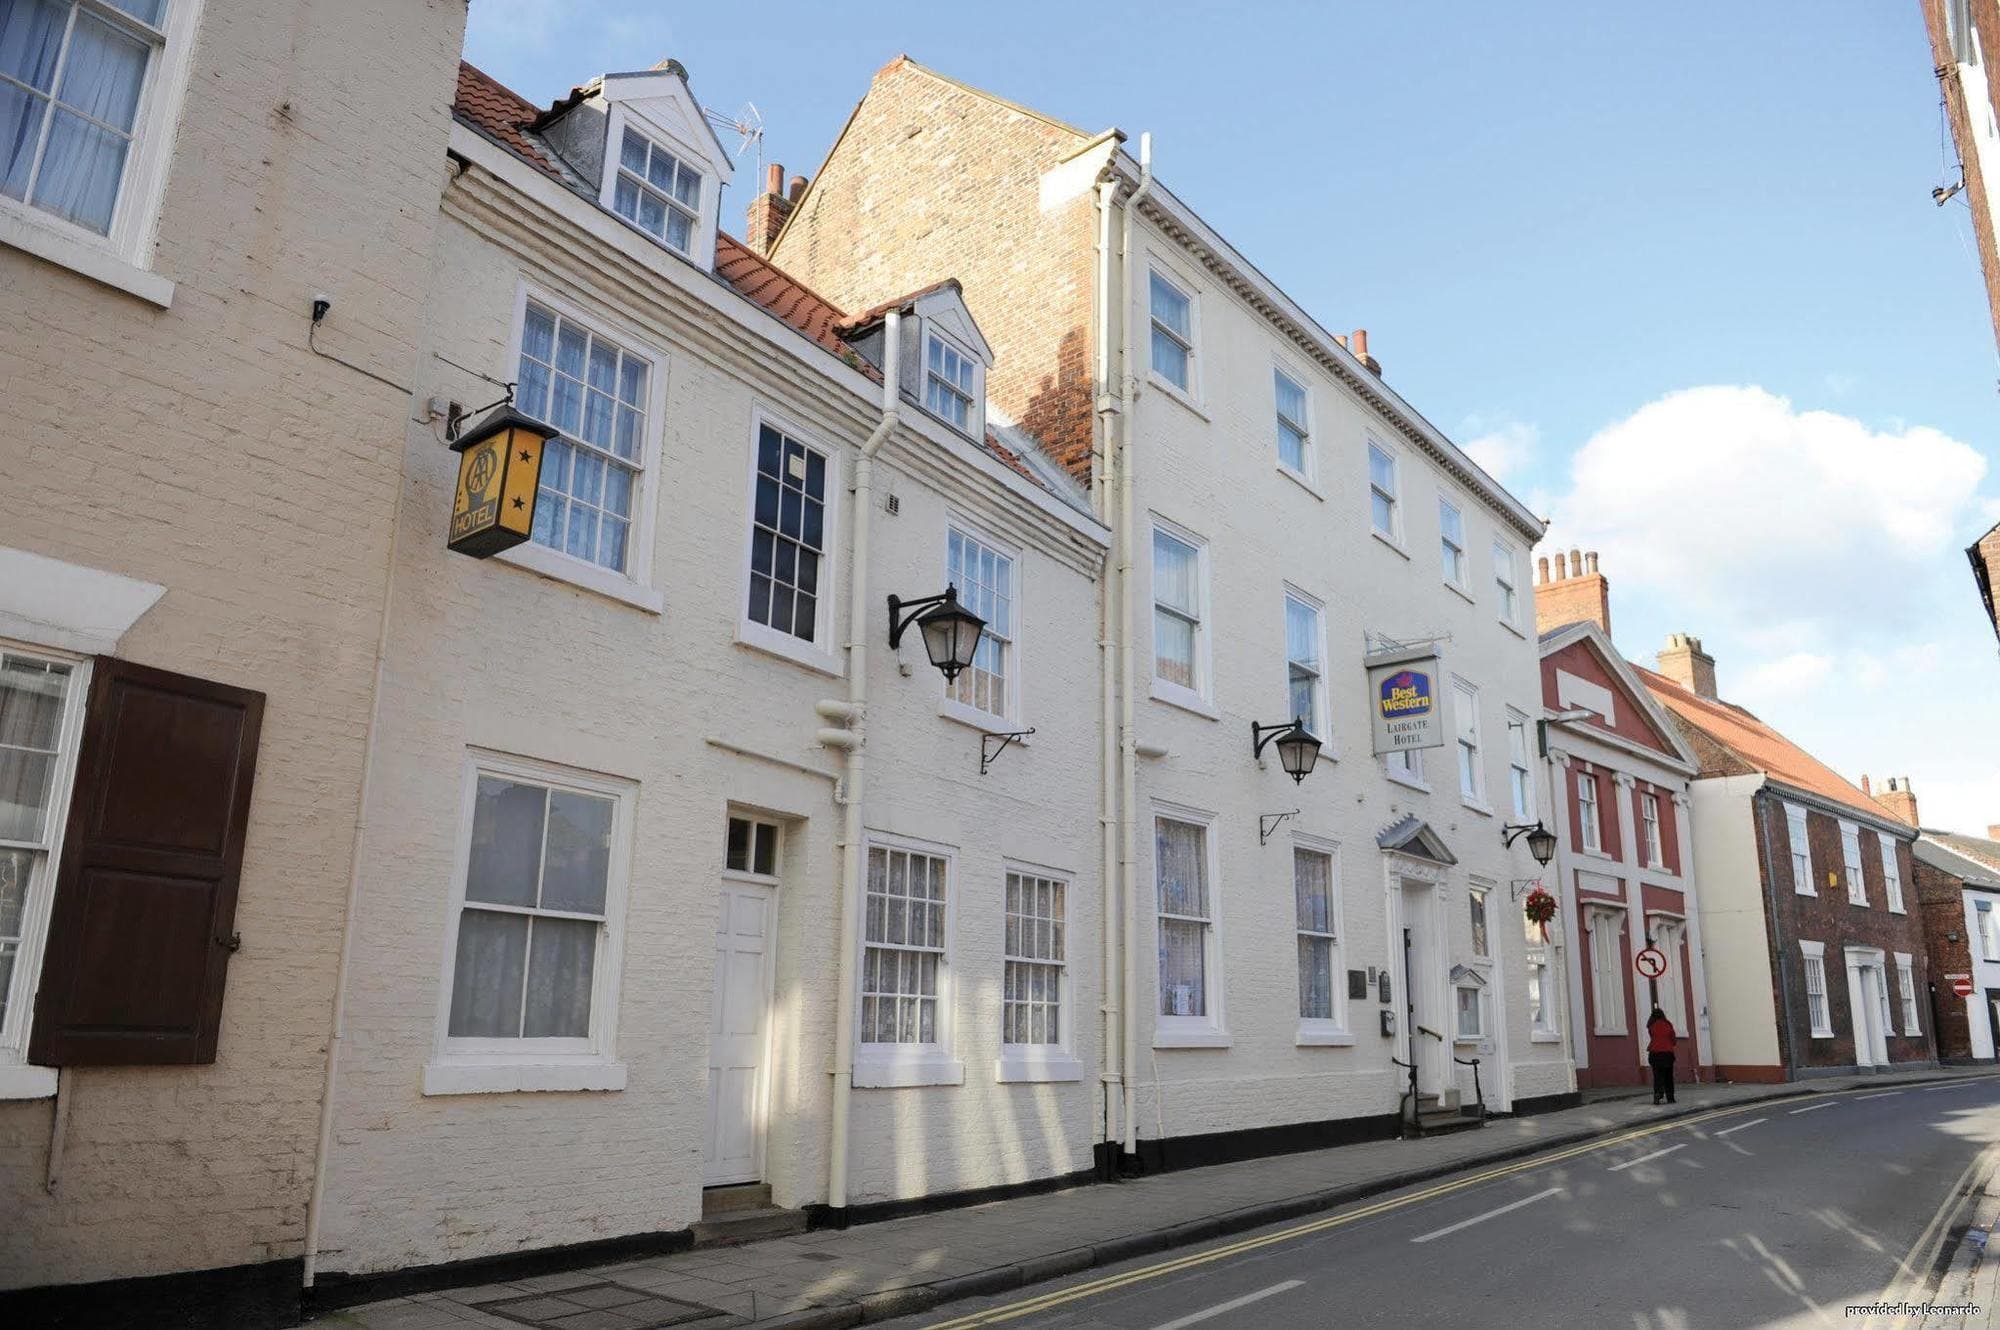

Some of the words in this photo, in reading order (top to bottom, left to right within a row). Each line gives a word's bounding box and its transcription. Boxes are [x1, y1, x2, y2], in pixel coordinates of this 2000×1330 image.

[455, 505, 493, 536] HOTEL
[1391, 685, 1418, 701] Best
[1383, 696, 1432, 711] Western
